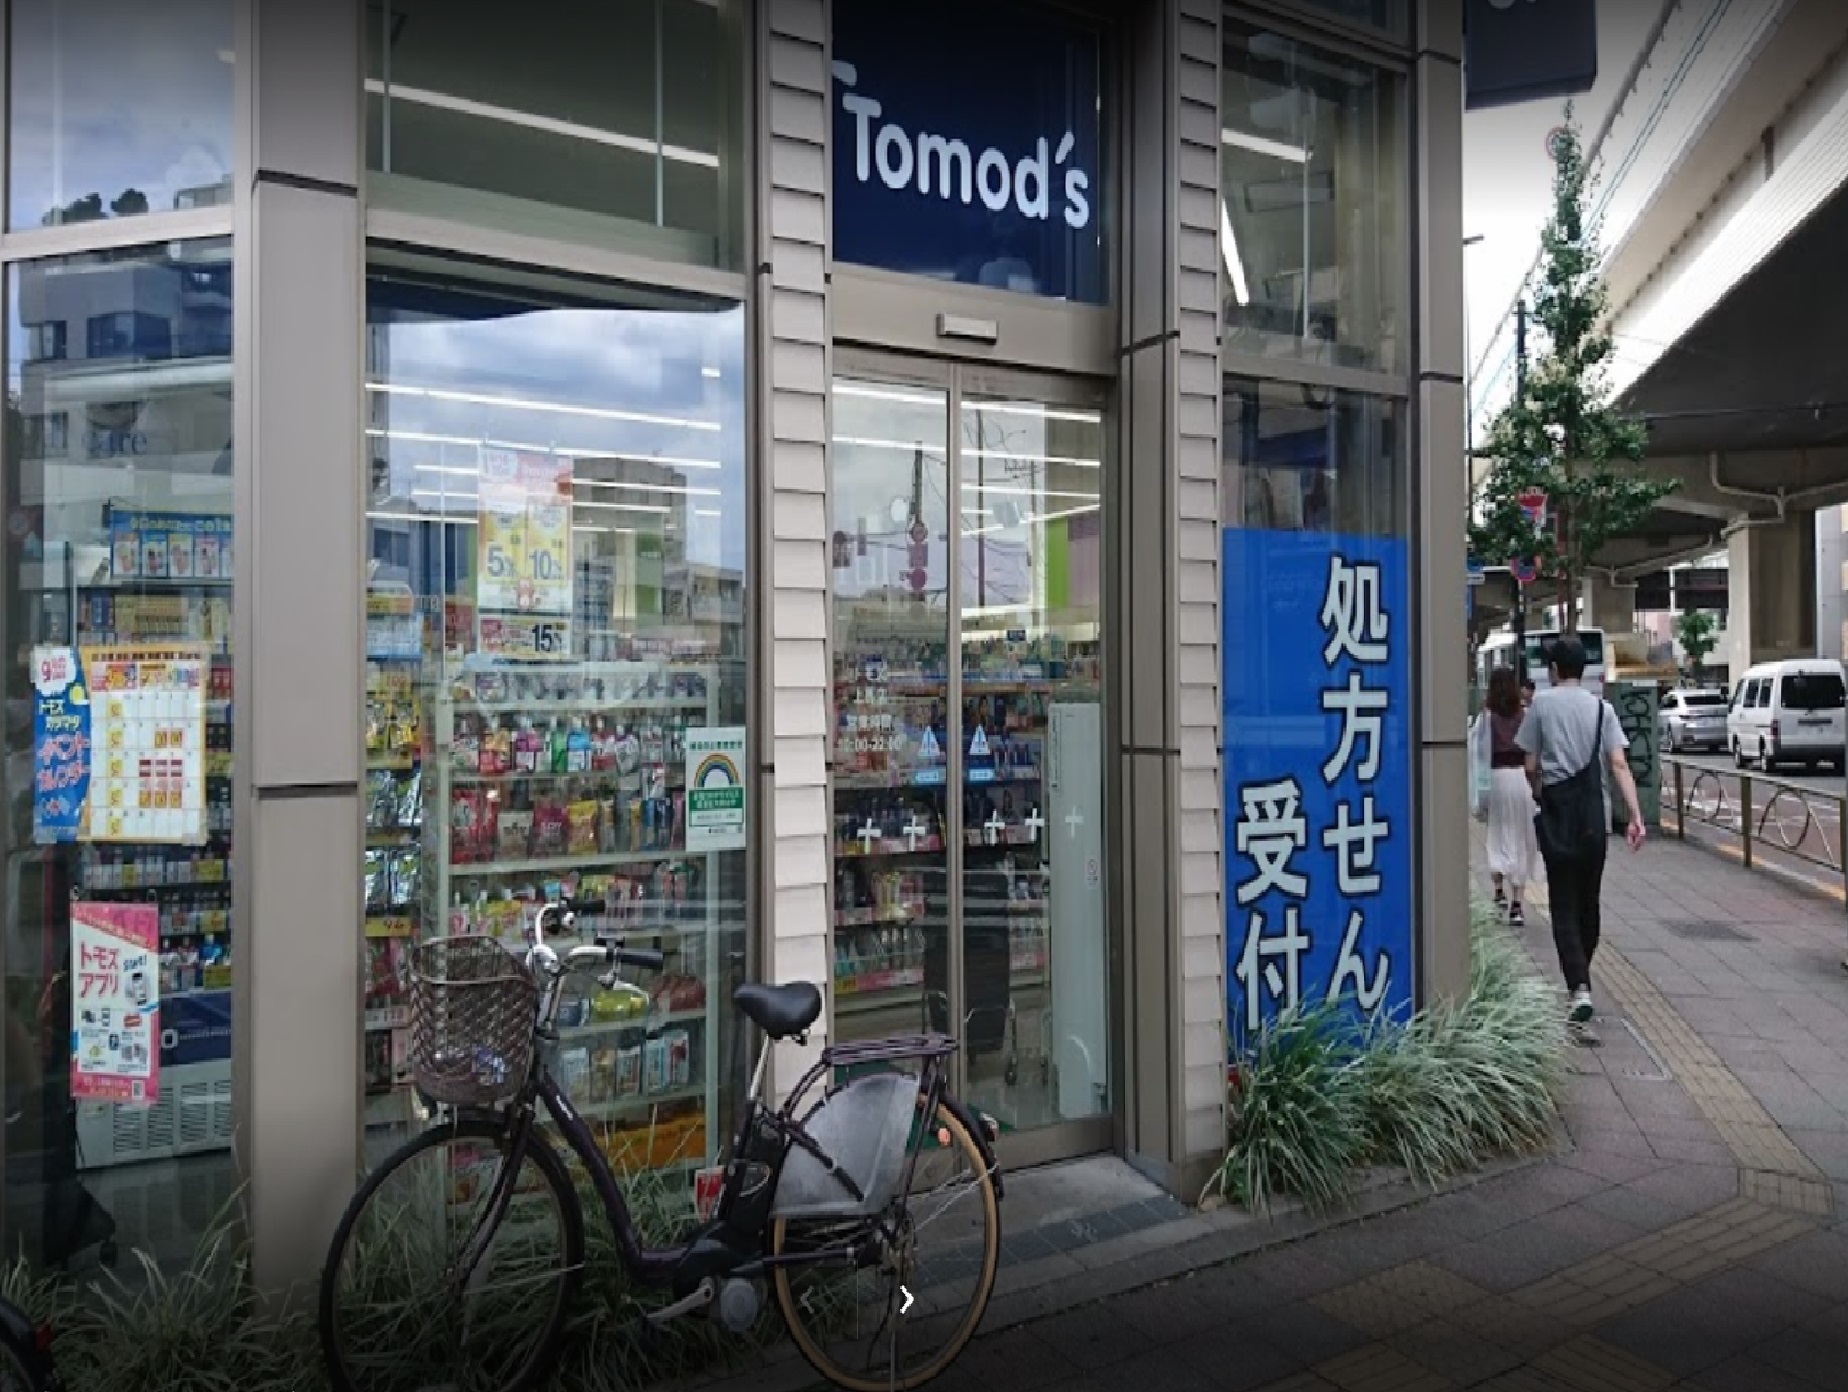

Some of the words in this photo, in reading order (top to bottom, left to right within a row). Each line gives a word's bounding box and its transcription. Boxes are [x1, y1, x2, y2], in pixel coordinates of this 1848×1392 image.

[842, 92, 1089, 228] Tomod's
[1321, 556, 1389, 1010] 処方せん
[78, 972, 119, 998] アプリ
[1236, 778, 1309, 1031] 受付
